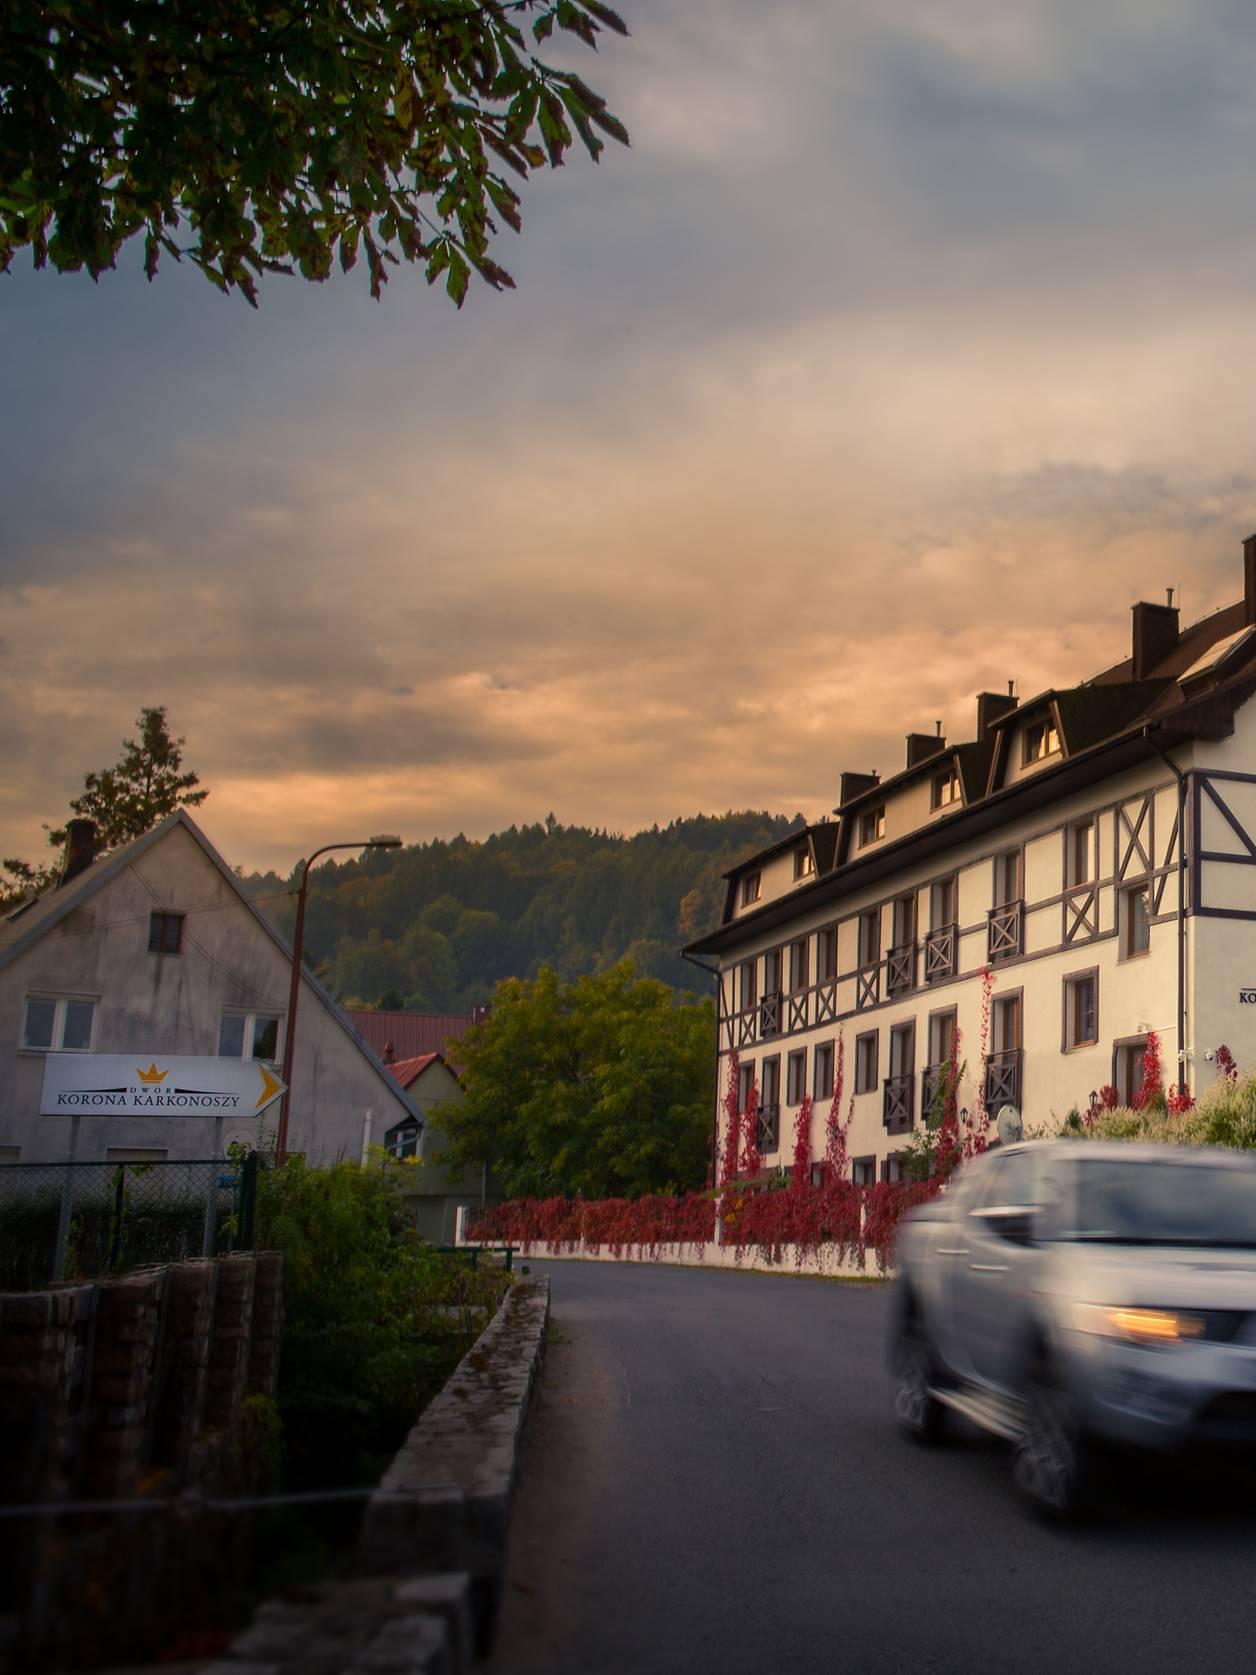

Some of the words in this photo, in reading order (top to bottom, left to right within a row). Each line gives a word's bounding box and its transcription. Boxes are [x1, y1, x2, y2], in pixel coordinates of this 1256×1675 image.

[130, 1085, 172, 1094] DWÓR
[57, 1094, 127, 1106] KORONA
[133, 1095, 240, 1107] KARKONOSZY
